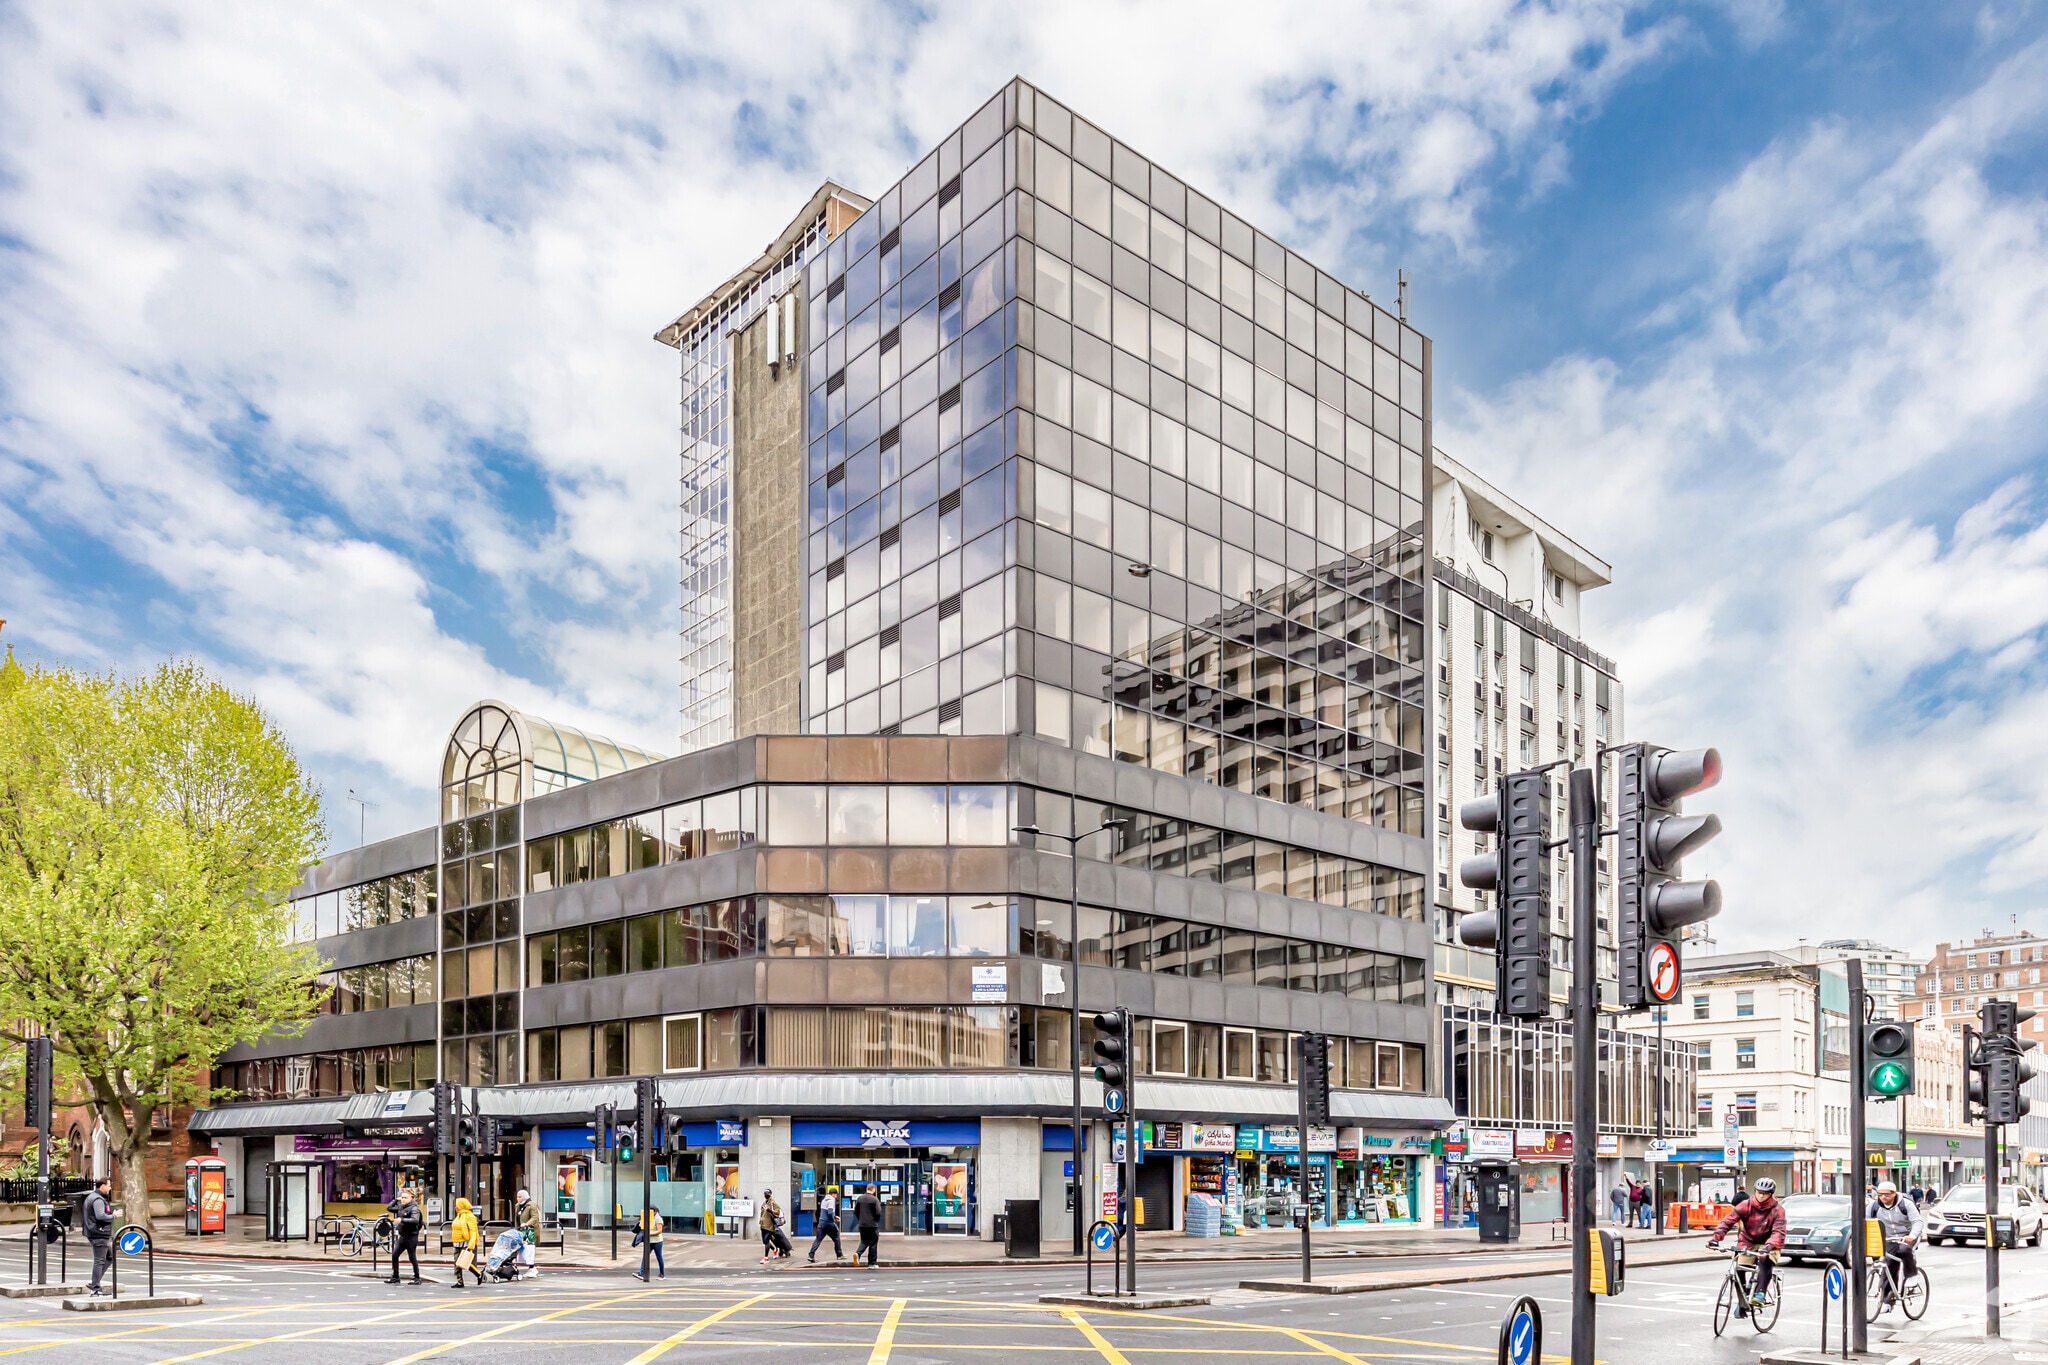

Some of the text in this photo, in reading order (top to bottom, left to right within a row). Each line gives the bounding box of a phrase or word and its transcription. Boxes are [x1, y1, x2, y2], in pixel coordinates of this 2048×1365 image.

[720, 1128, 743, 1136] HALIFAX
[861, 1129, 911, 1138] HALIFAX
[1367, 1135, 1394, 1148] Pharmacy
[1450, 1133, 1460, 1142] NHS
